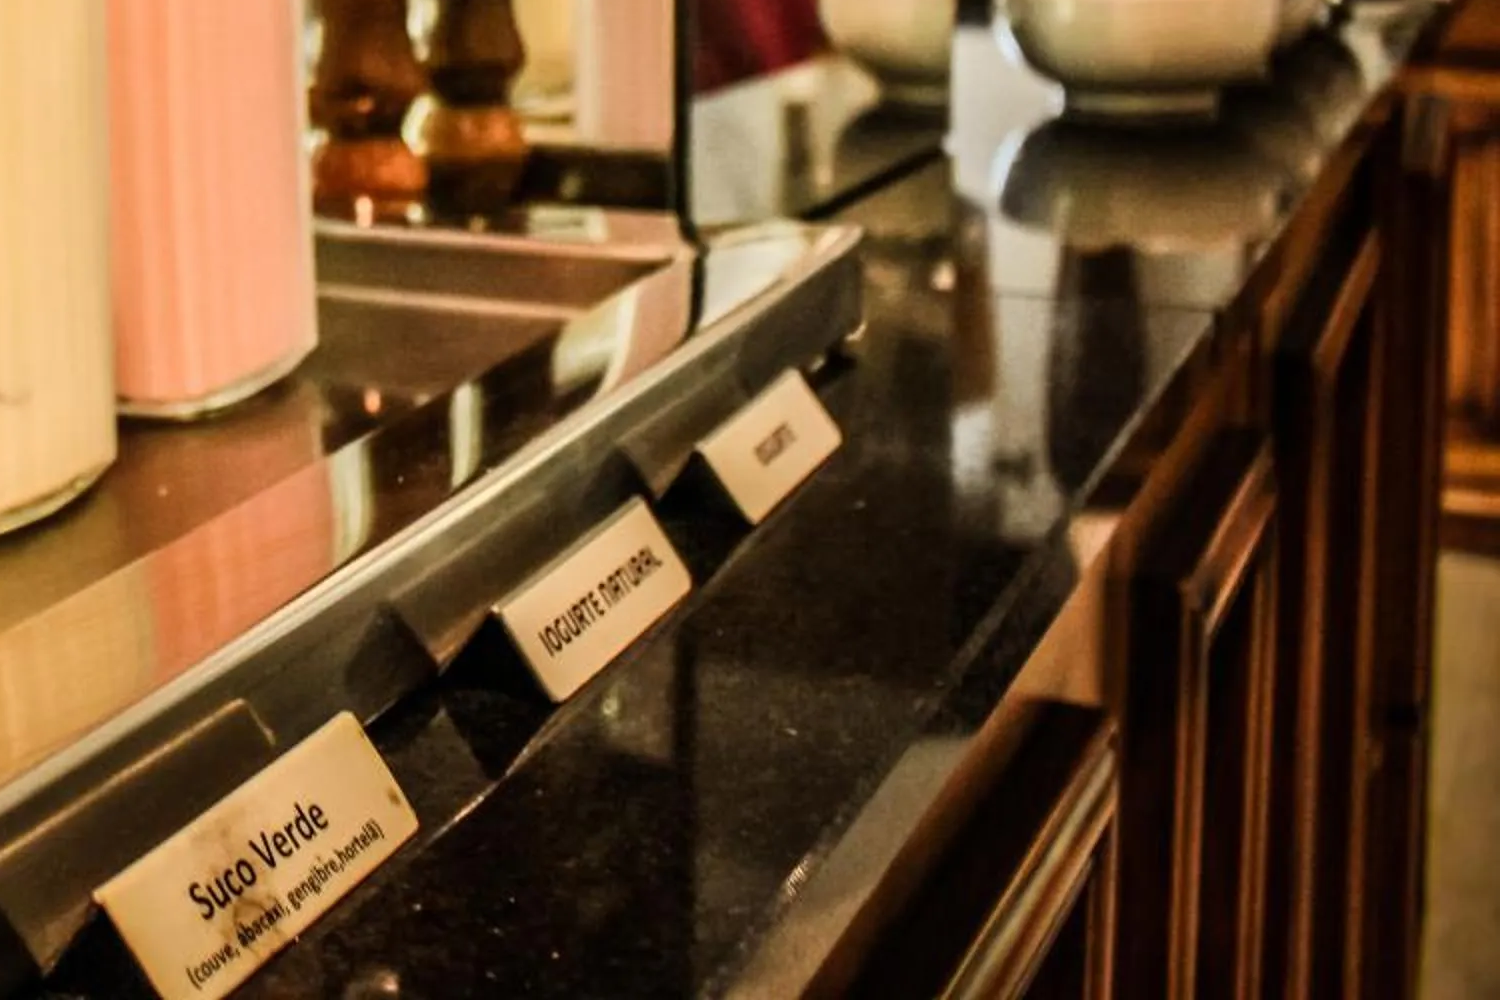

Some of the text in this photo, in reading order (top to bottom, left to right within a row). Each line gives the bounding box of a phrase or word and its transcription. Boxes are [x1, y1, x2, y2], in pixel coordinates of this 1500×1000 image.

[537, 591, 605, 657] IOGURTE
[188, 801, 329, 921] Suco Verde
[185, 942, 241, 990] (couve,
